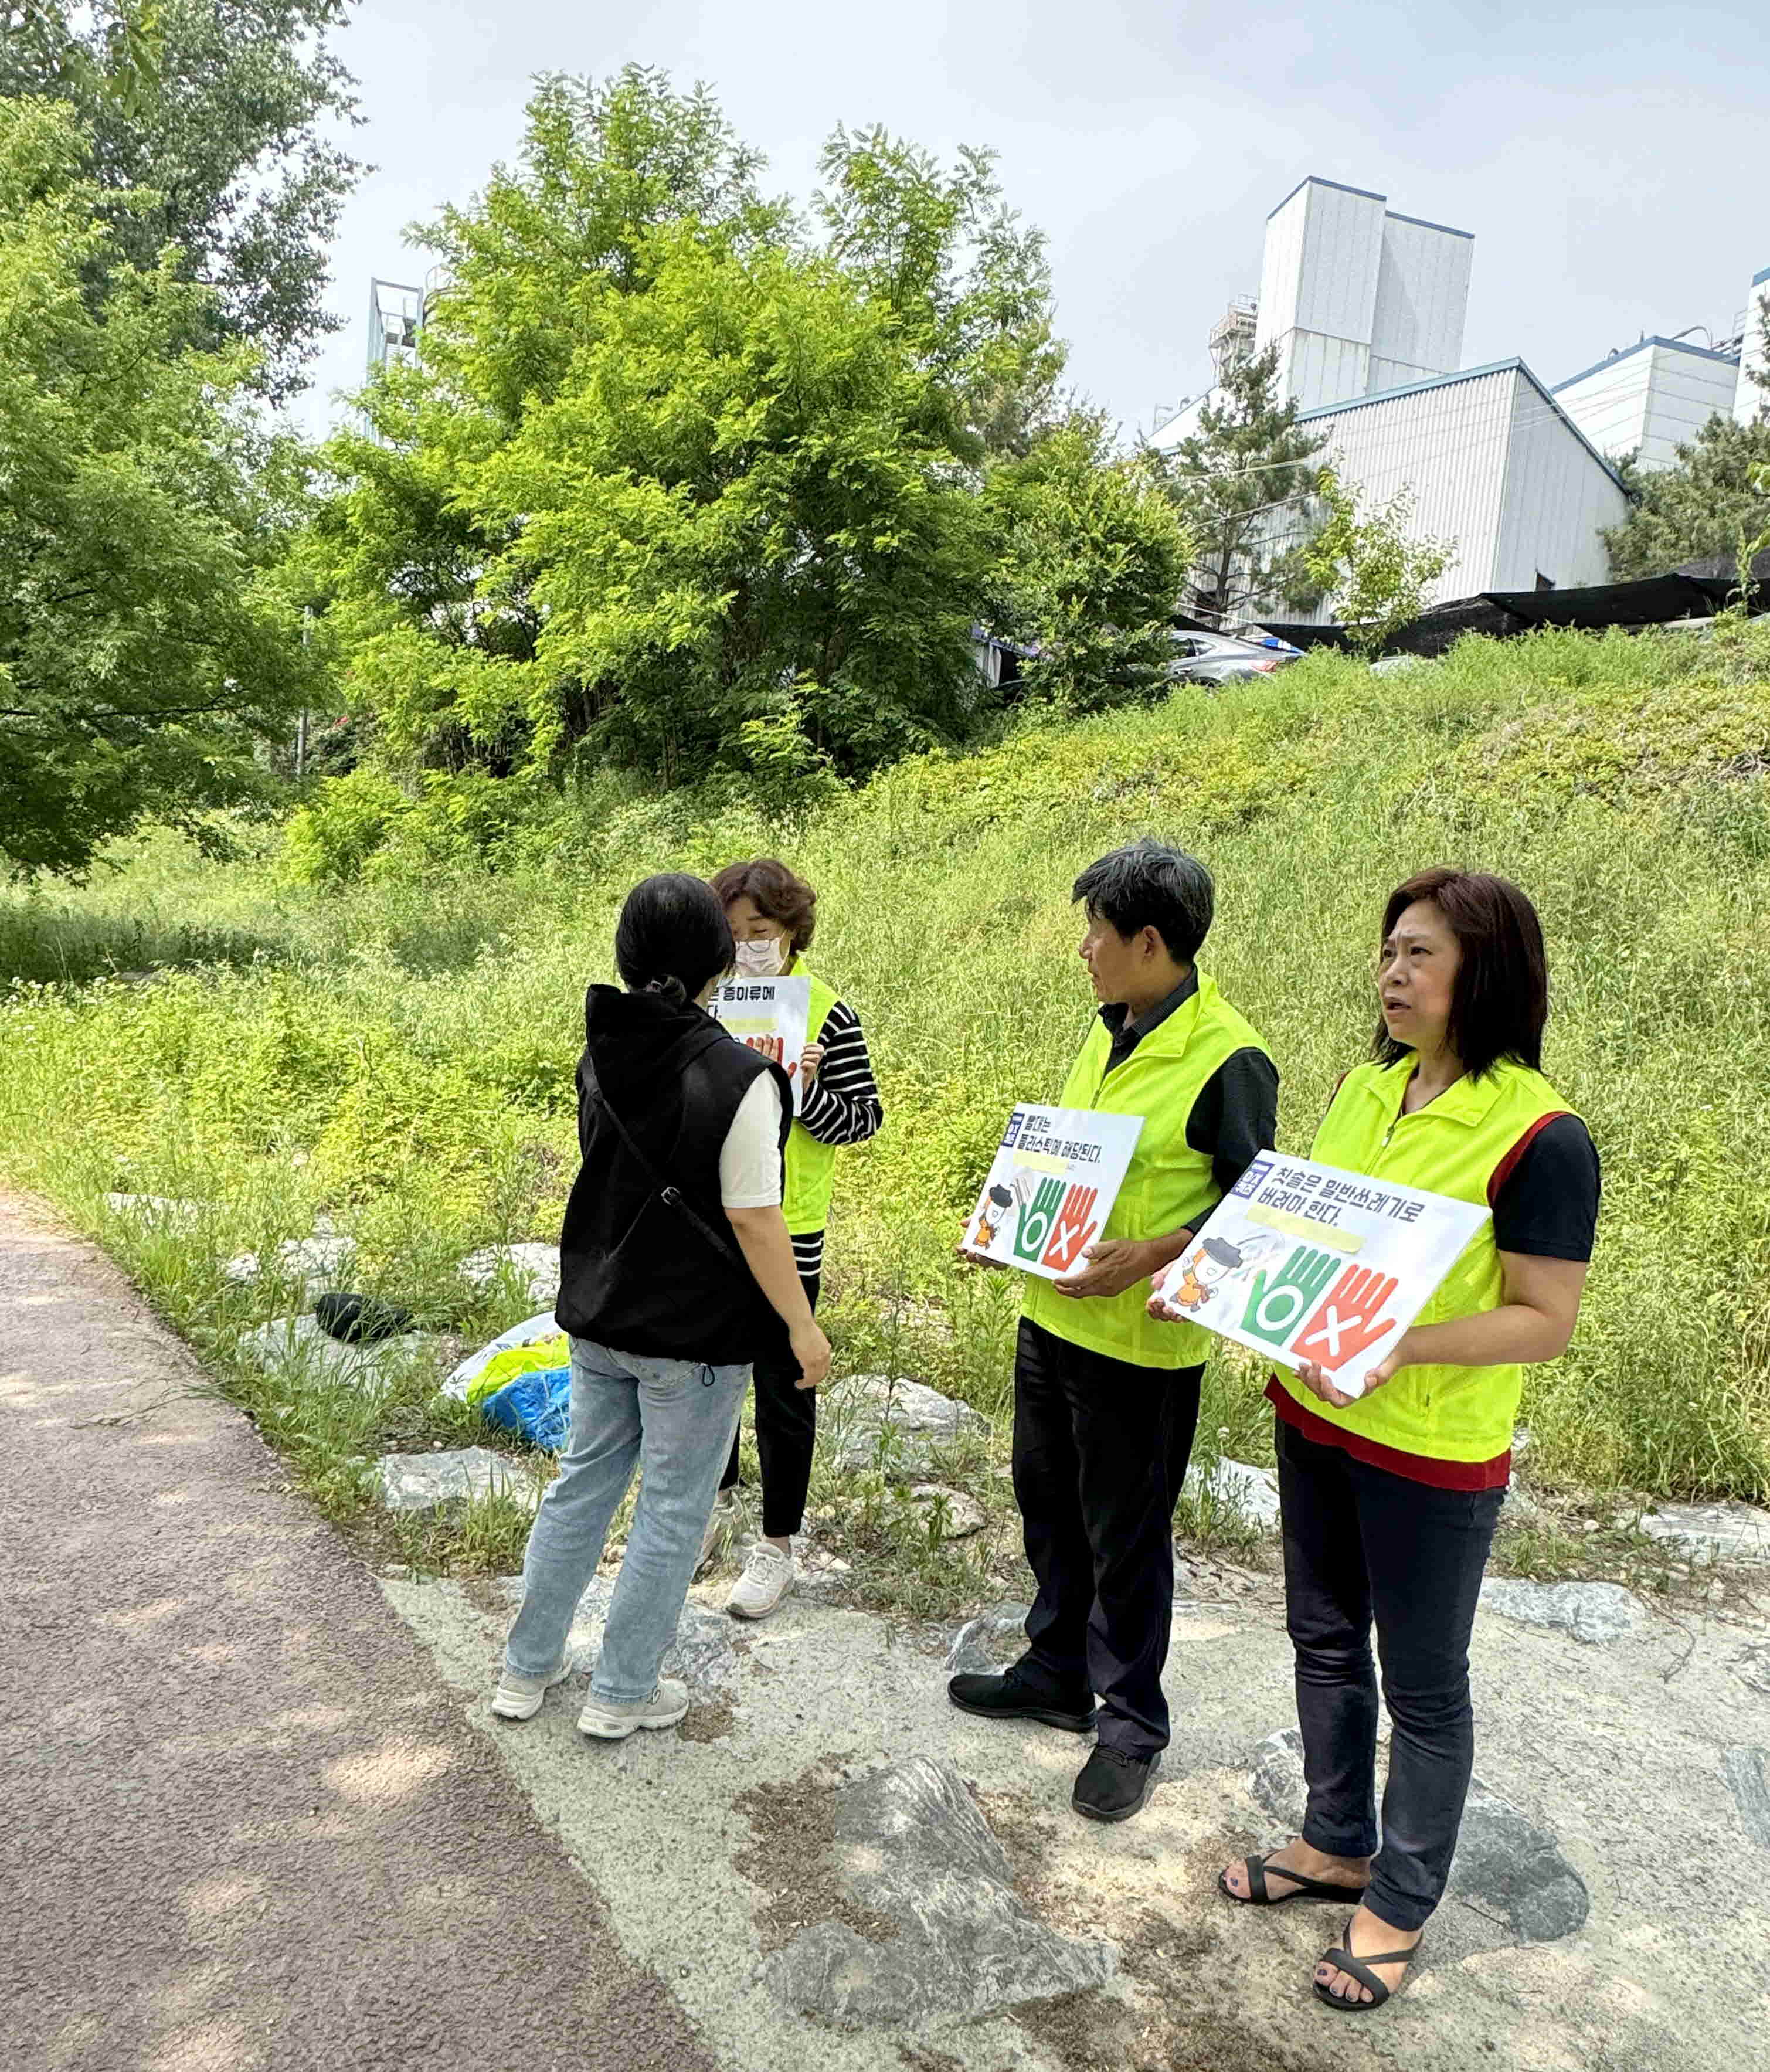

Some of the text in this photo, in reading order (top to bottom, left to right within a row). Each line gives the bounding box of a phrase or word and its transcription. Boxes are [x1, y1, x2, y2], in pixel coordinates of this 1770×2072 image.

[722, 986, 776, 1001] 종이류에
[1271, 1166, 1323, 1194] 칫솔은
[1318, 1178, 1426, 1223] 일반쓰레기로
[1303, 1200, 1342, 1227] 한다.
